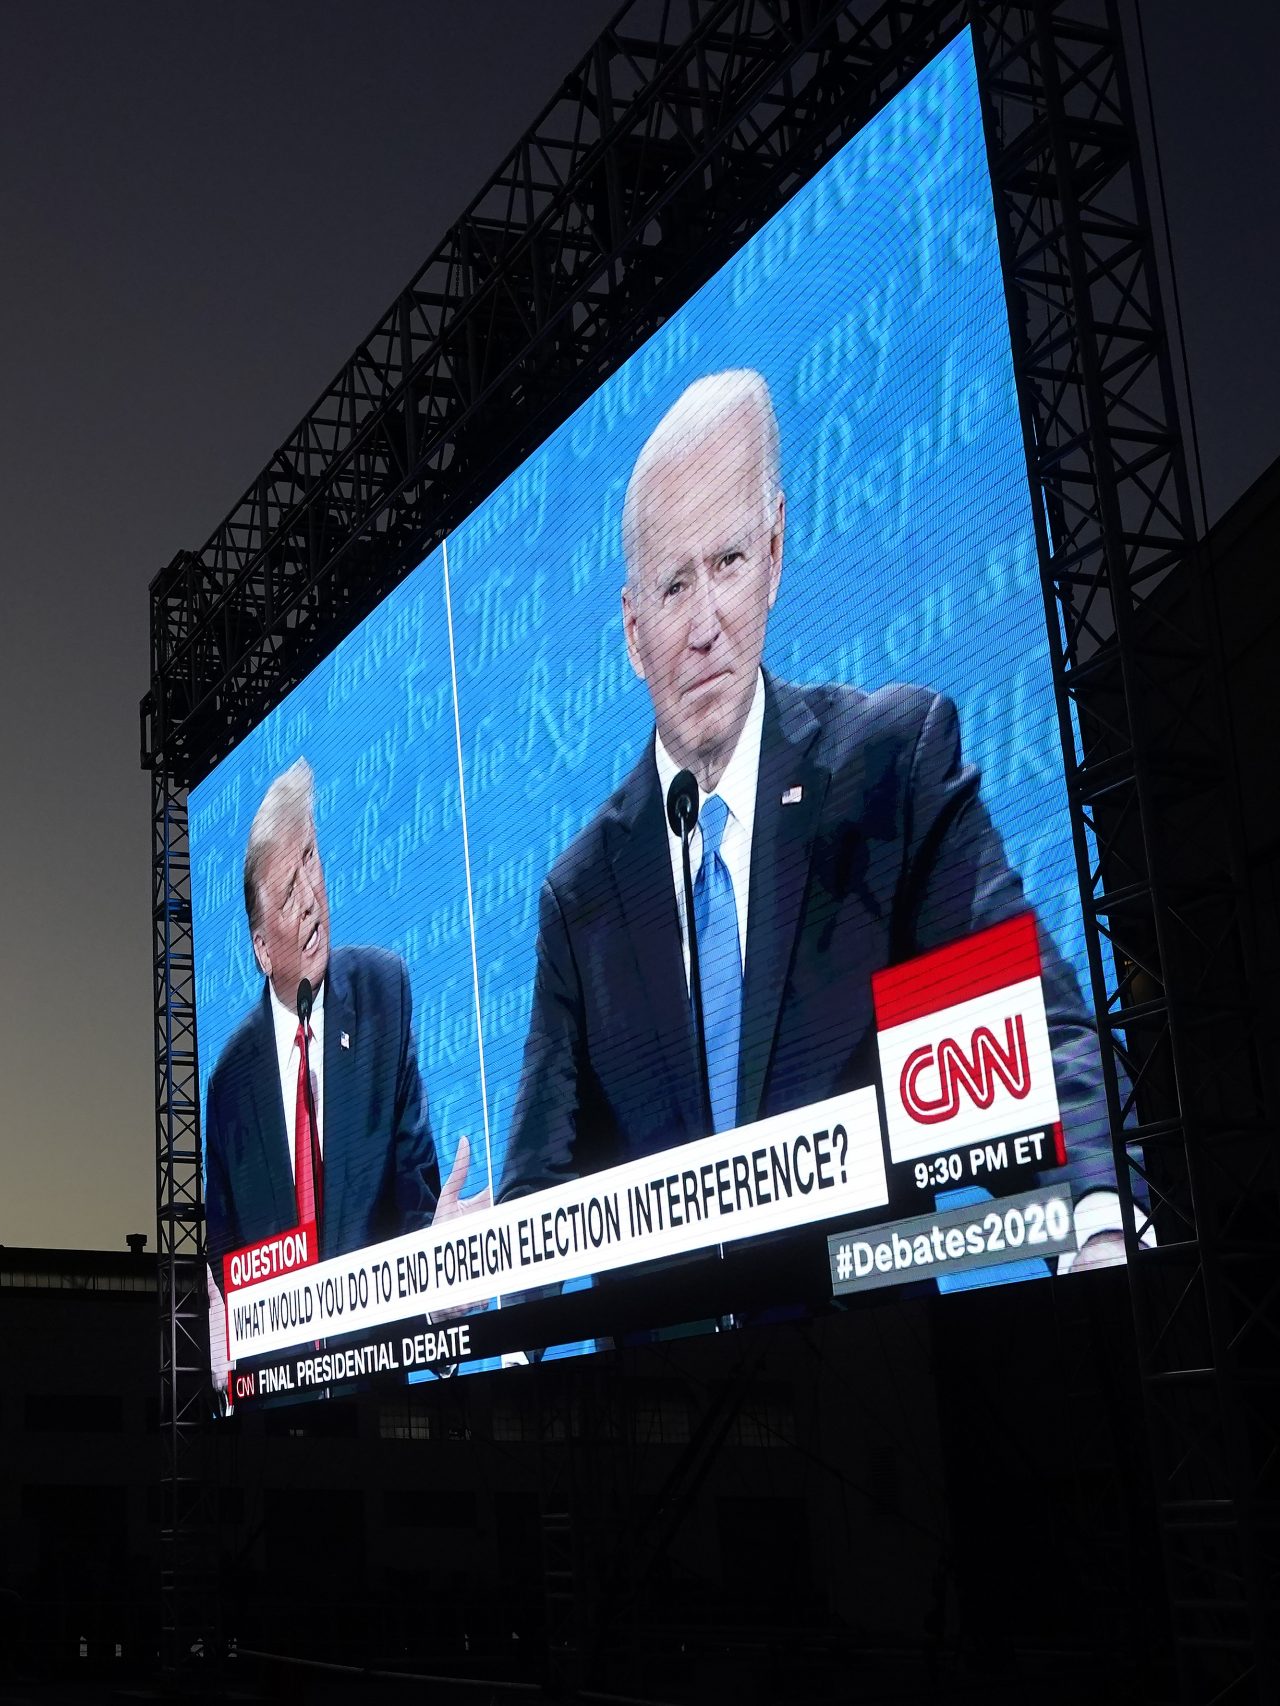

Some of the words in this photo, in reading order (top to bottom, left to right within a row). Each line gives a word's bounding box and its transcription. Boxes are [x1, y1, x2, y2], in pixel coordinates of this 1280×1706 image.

[900, 1015, 1031, 1124] CNN
[915, 1154, 962, 1188] 9:30
[970, 1143, 1007, 1175] PM
[1014, 1132, 1044, 1164] ET
[231, 1232, 308, 1285] QUESTION
[234, 1302, 265, 1341] WHAT
[271, 1287, 312, 1331] WOULD
[317, 1277, 343, 1318] YOU
[349, 1268, 368, 1310] DO
[372, 1261, 391, 1303] TO
[397, 1252, 428, 1297] END
[435, 1226, 512, 1288] FOREIGN
[518, 1193, 620, 1265] ELECTION
[628, 1124, 849, 1236] INTERFERENCE?
[837, 1198, 1069, 1280] #Debates2020
[237, 1373, 254, 1397] CNN
[259, 1365, 294, 1394] FINAL
[297, 1342, 398, 1386] PRESIDENTIAL
[403, 1325, 471, 1367] DEBATE
